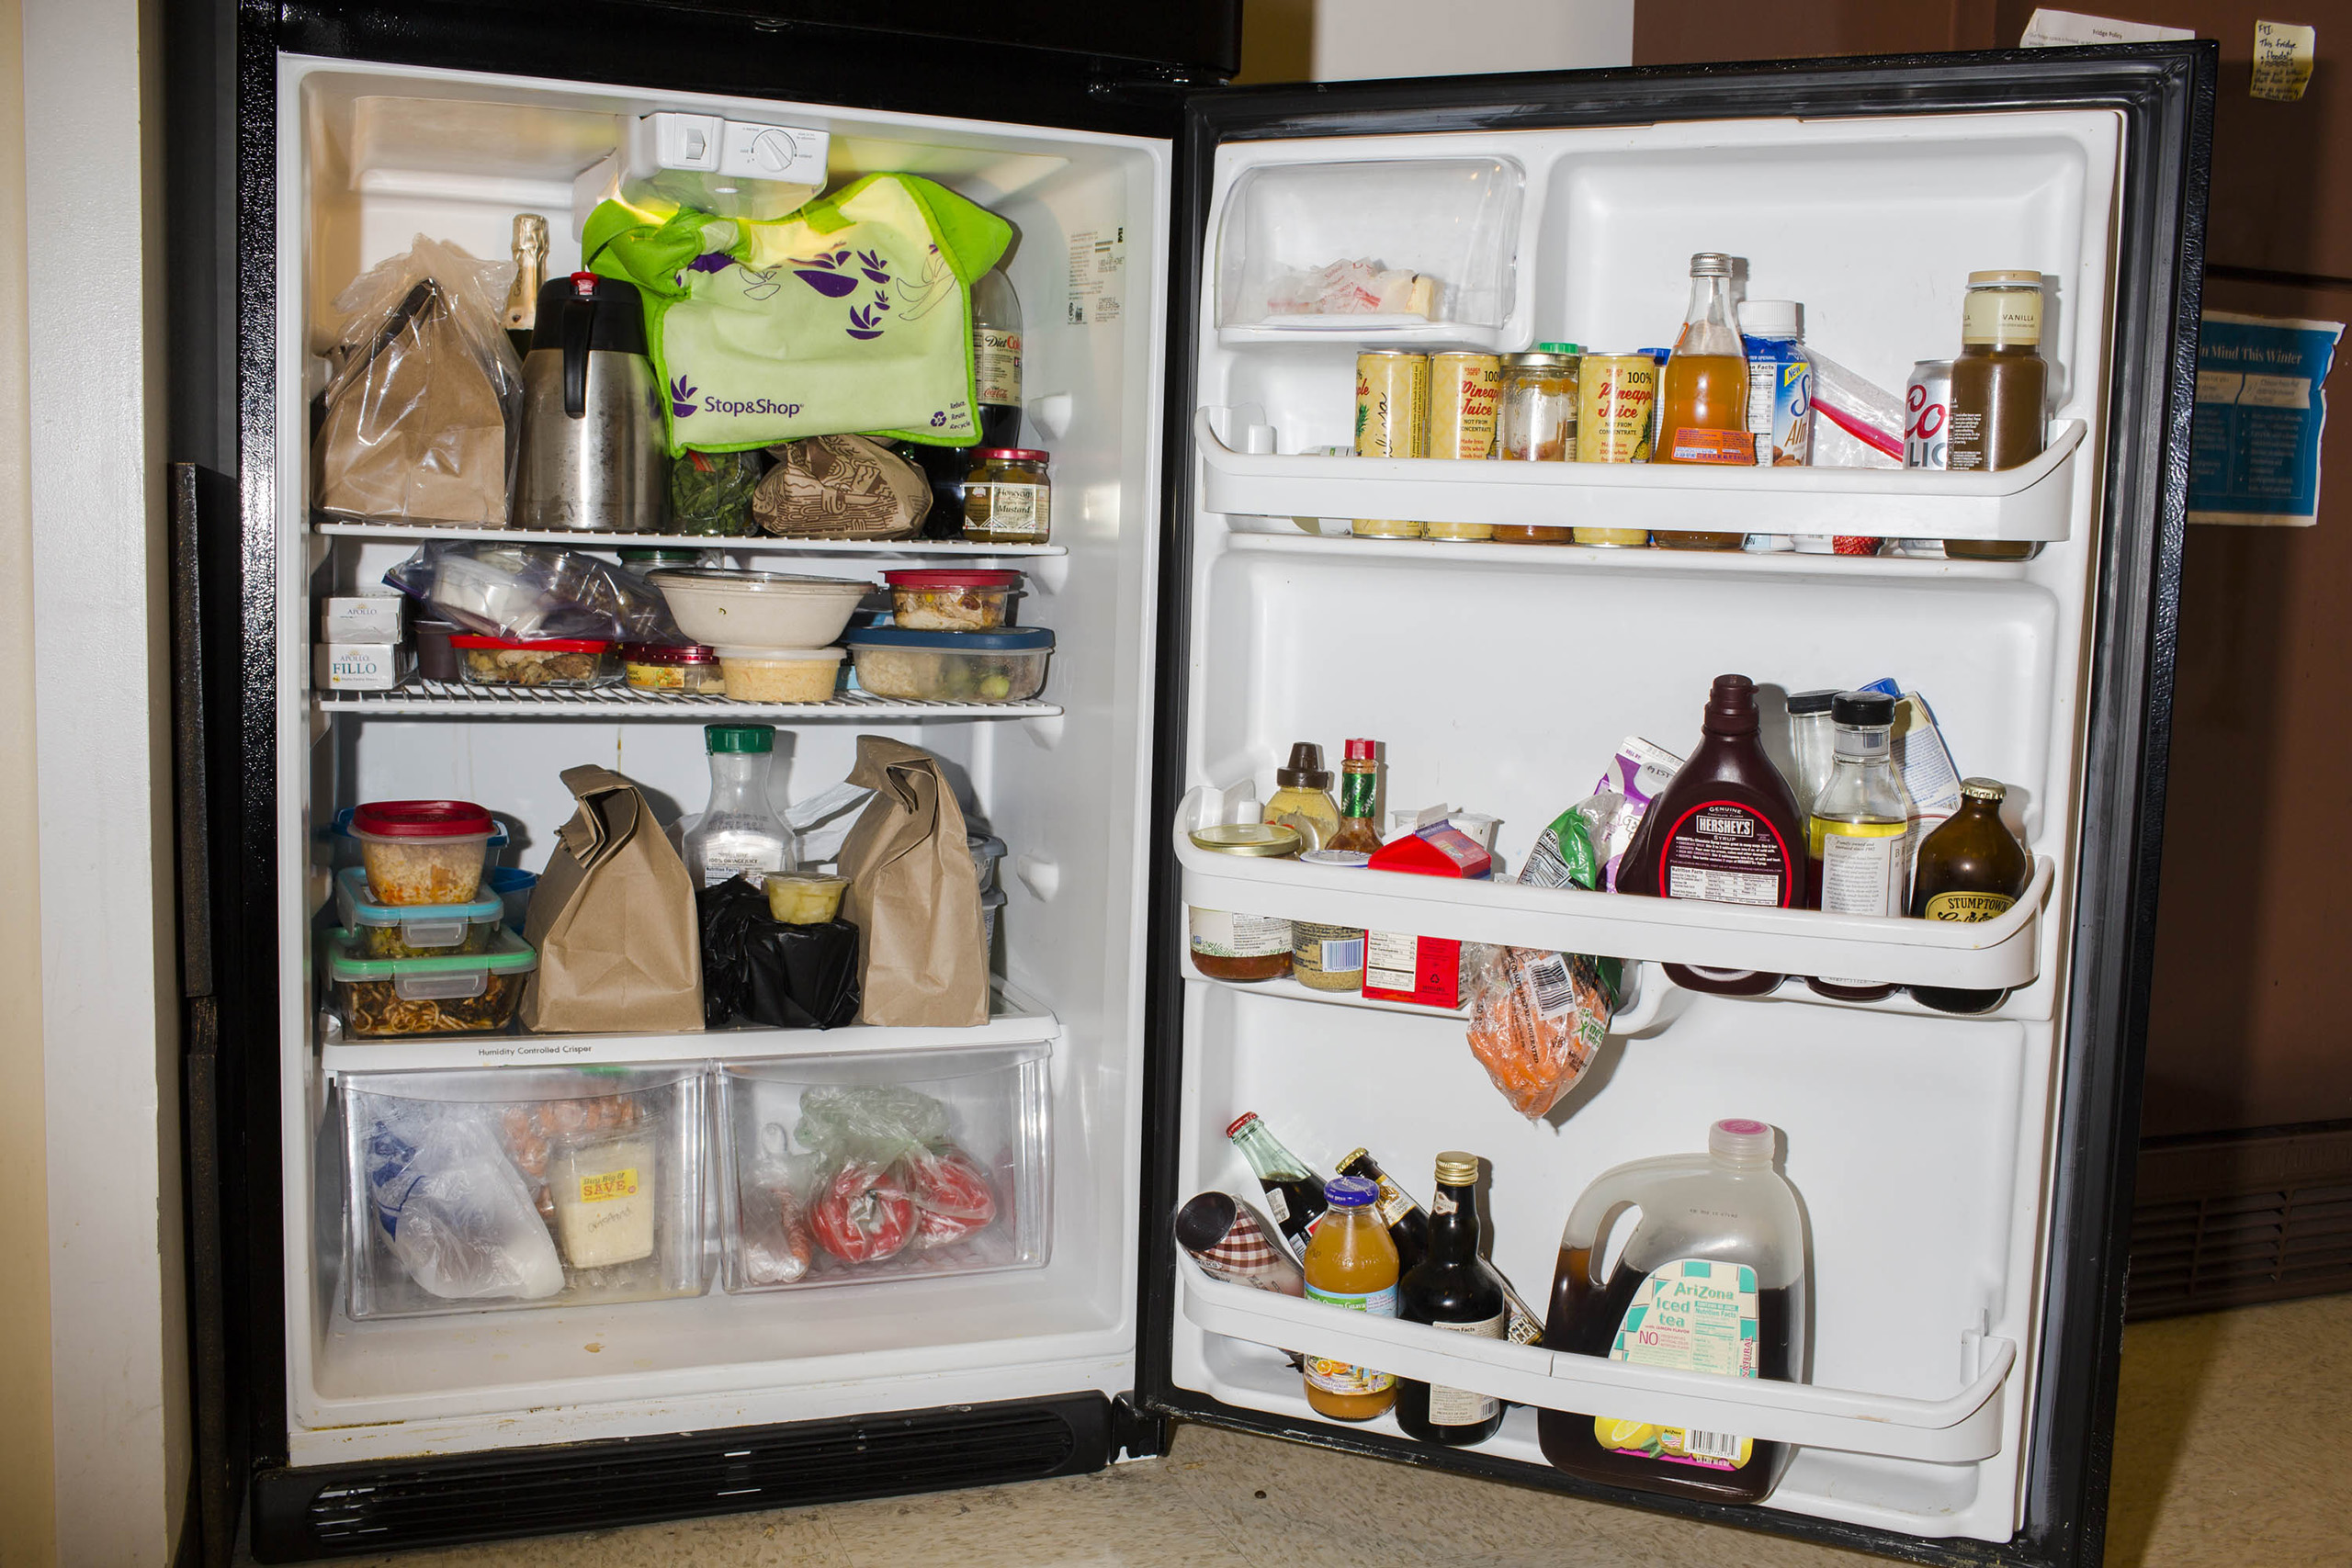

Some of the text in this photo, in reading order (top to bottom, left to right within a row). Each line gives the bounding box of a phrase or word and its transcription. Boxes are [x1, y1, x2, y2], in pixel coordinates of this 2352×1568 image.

[2093, 28, 2108, 37] Fridge
[985, 334, 1007, 348] Diet
[2211, 345, 2239, 360] Mind
[2242, 347, 2264, 361] This
[2266, 349, 2302, 365] Winter
[1628, 372, 1652, 384] 100%
[1788, 365, 1801, 381] New
[704, 396, 800, 418] Stop&Shop
[1461, 398, 1492, 416] Juice
[951, 412, 966, 421] Reuse
[950, 421, 970, 430] Recycle
[998, 504, 1031, 513] Mustard
[333, 663, 377, 674] FILLO
[1699, 818, 1750, 835] HERSHEY'S
[478, 1045, 592, 1056] Humidity Controlled Crisper
[1674, 1281, 1734, 1300] AriZona
[1657, 1297, 1690, 1313] Iced
[1695, 1307, 1736, 1318] Nutrition Facts
[1658, 1313, 1685, 1328] tea
[1639, 1330, 1658, 1346] NO
